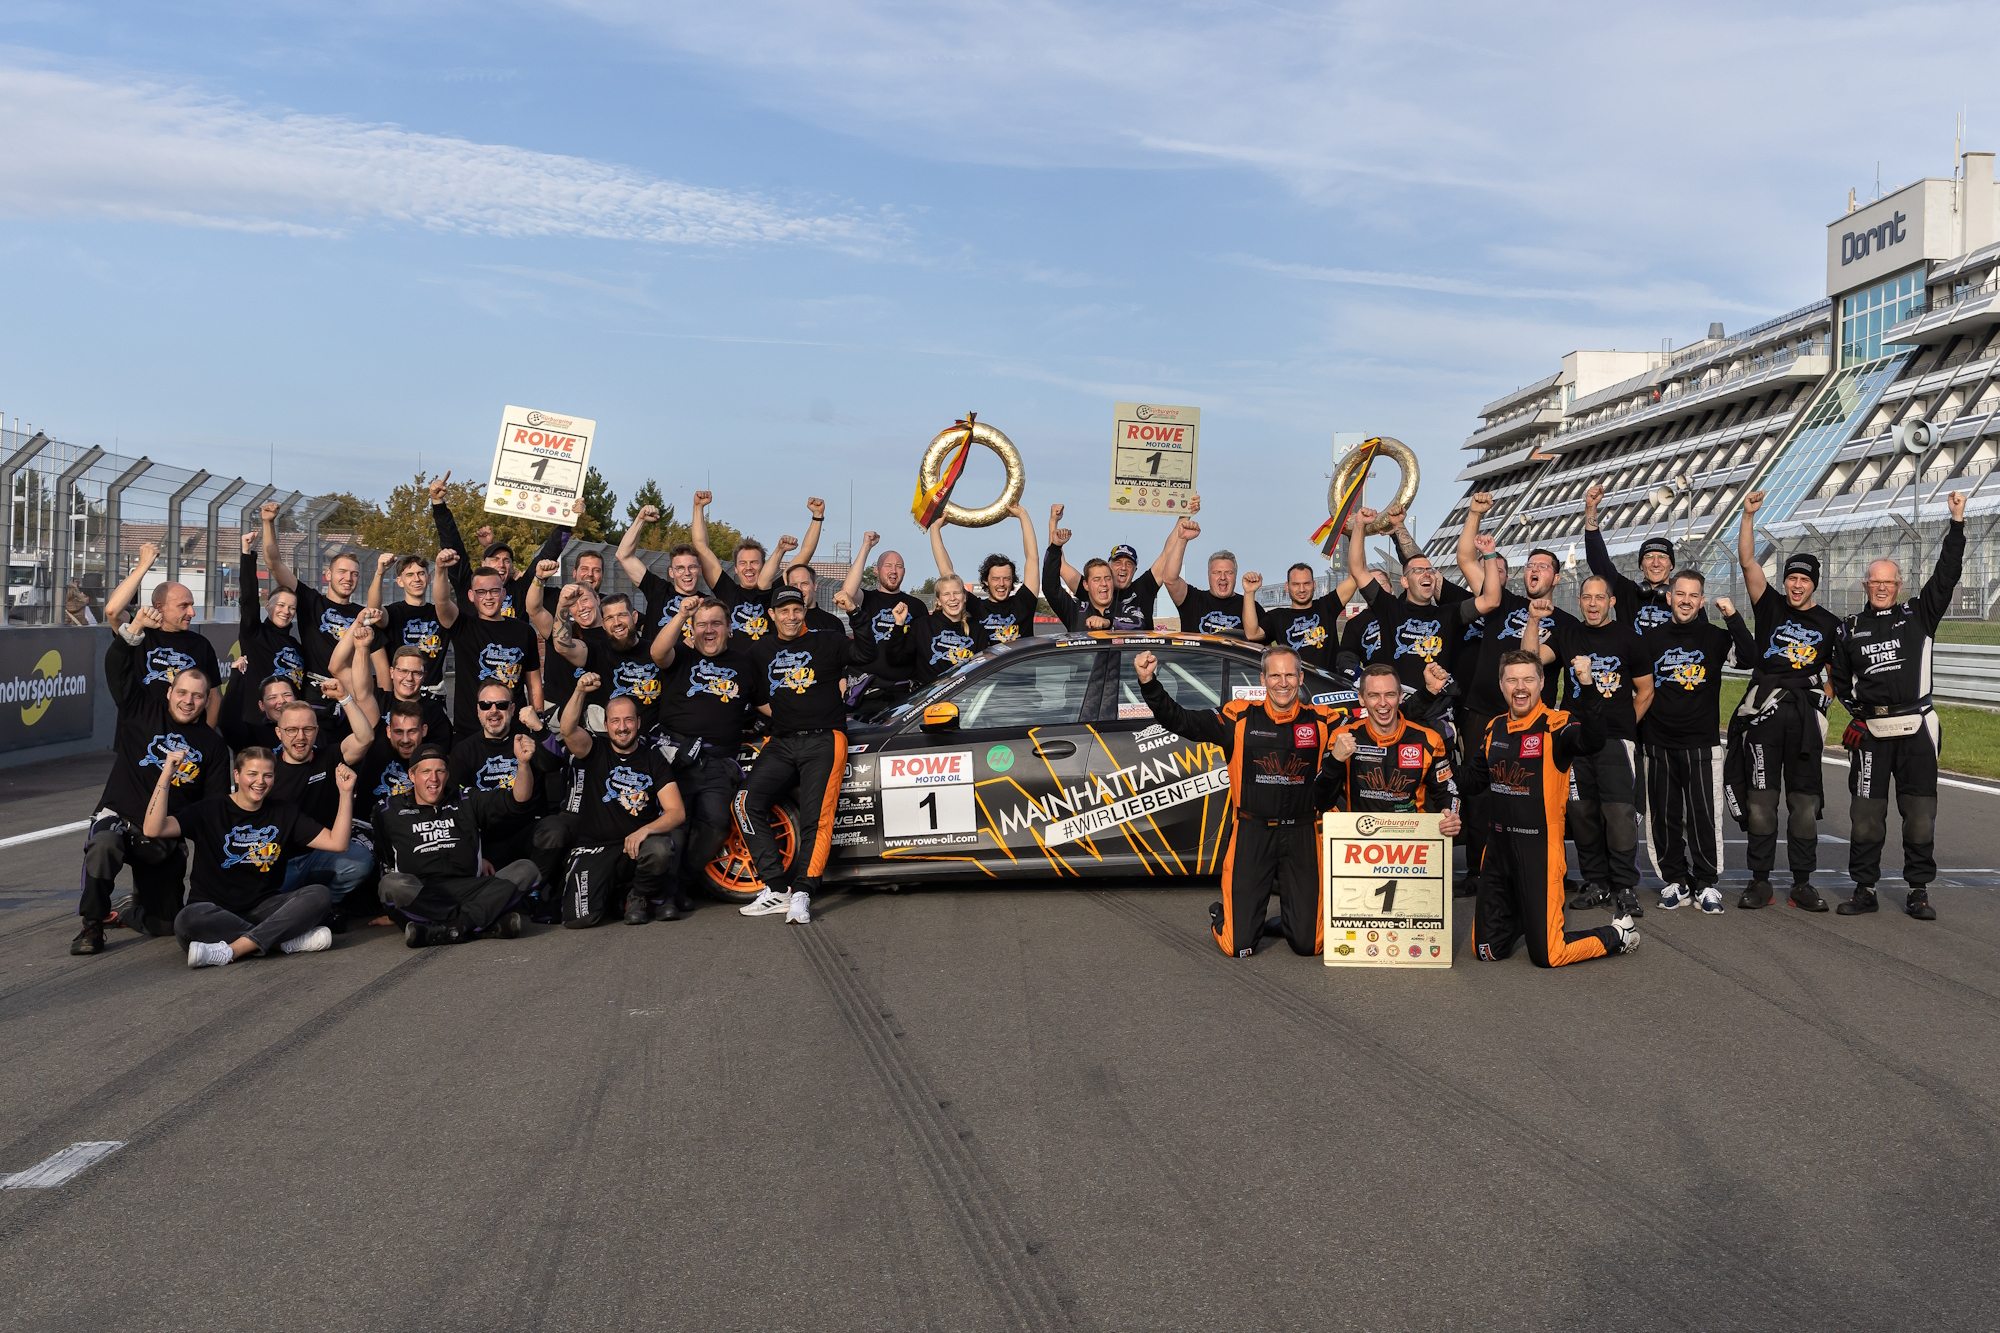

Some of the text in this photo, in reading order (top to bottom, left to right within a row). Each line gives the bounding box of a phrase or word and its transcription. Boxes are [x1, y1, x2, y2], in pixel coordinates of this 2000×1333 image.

[1841, 210, 1906, 266] Dorint
[514, 428, 576, 452] ROWE
[1127, 424, 1184, 442] ROWE
[533, 447, 559, 458] MOTOR
[1145, 441, 1171, 449] MOTOR
[530, 458, 550, 482] 1
[1145, 451, 1163, 477] 1
[496, 479, 575, 498] www.rowe-oil.com
[1116, 479, 1190, 489] www.rowe-oil.com
[1861, 638, 1901, 655] NEXEN
[1868, 651, 1897, 664] TIRE
[906, 676, 967, 720] ADRENALIN MOTORSPORT
[1318, 692, 1355, 703] BASTUCK
[1137, 733, 1179, 753] BAHCO
[890, 755, 961, 777] ROWE
[1755, 743, 1767, 790] NEXEN TIRE
[1862, 751, 1873, 799] NEXEN TIRE
[915, 775, 946, 784] MOTOR
[572, 769, 585, 814] NEXEN TIRE
[1570, 782, 1580, 801] TIRE
[1726, 784, 1742, 817] NEXEN TIRE
[919, 792, 938, 830] 1
[1063, 769, 1230, 840] #WIRLIEBENFELG
[412, 818, 455, 833] NEXEN
[1375, 818, 1420, 827] nürburgring
[420, 829, 451, 842] TIRE
[832, 831, 862, 839] ANSPORT
[885, 834, 977, 847] www.rowe-oil.com
[1344, 843, 1429, 865] ROWE
[1373, 866, 1428, 874] MOTOR OIL
[580, 870, 590, 917] NEXEN TIRE
[1375, 880, 1398, 915] 1
[1333, 920, 1442, 929] www.rowe-oil.com
